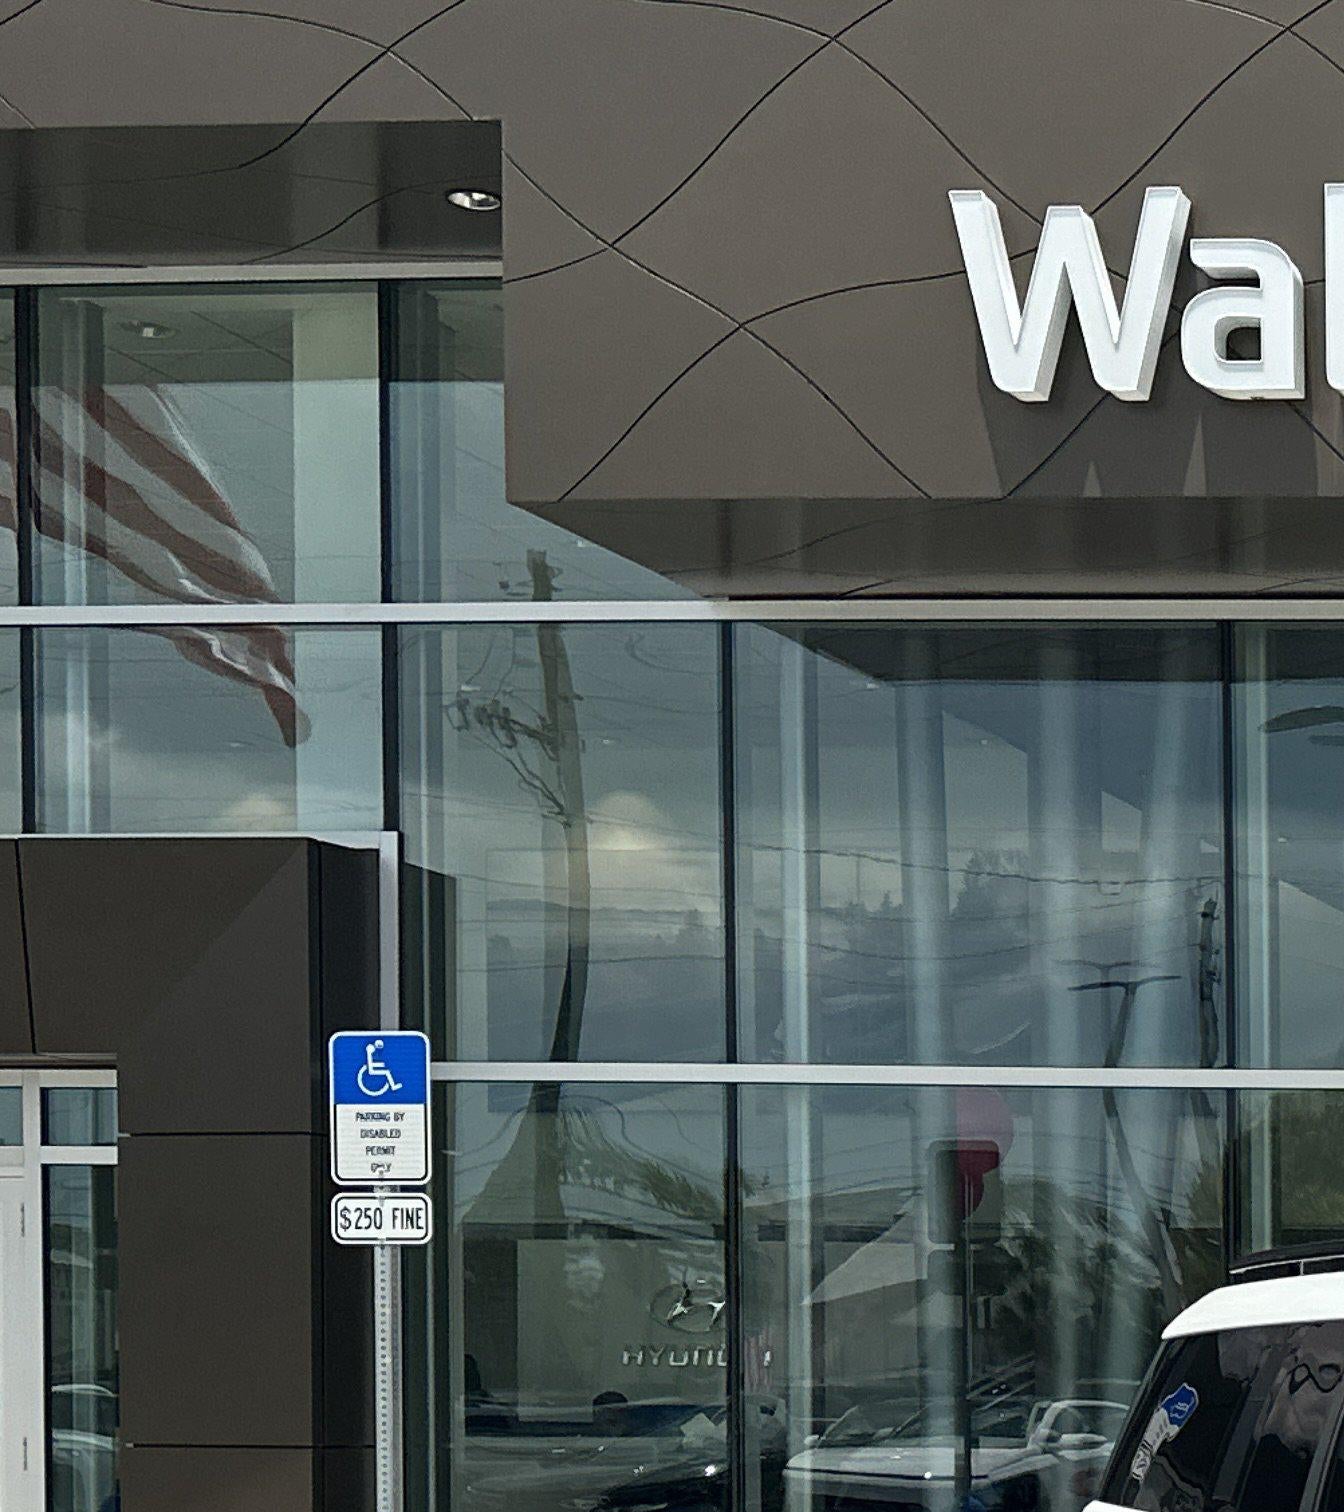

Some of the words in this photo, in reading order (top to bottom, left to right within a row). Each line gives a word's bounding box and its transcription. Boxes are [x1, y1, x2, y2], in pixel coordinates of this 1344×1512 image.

[360, 1128, 401, 1138] DISABLED
[340, 1206, 383, 1231] $250
[392, 1207, 424, 1230] FINE
[622, 1348, 772, 1367] HYUNI
